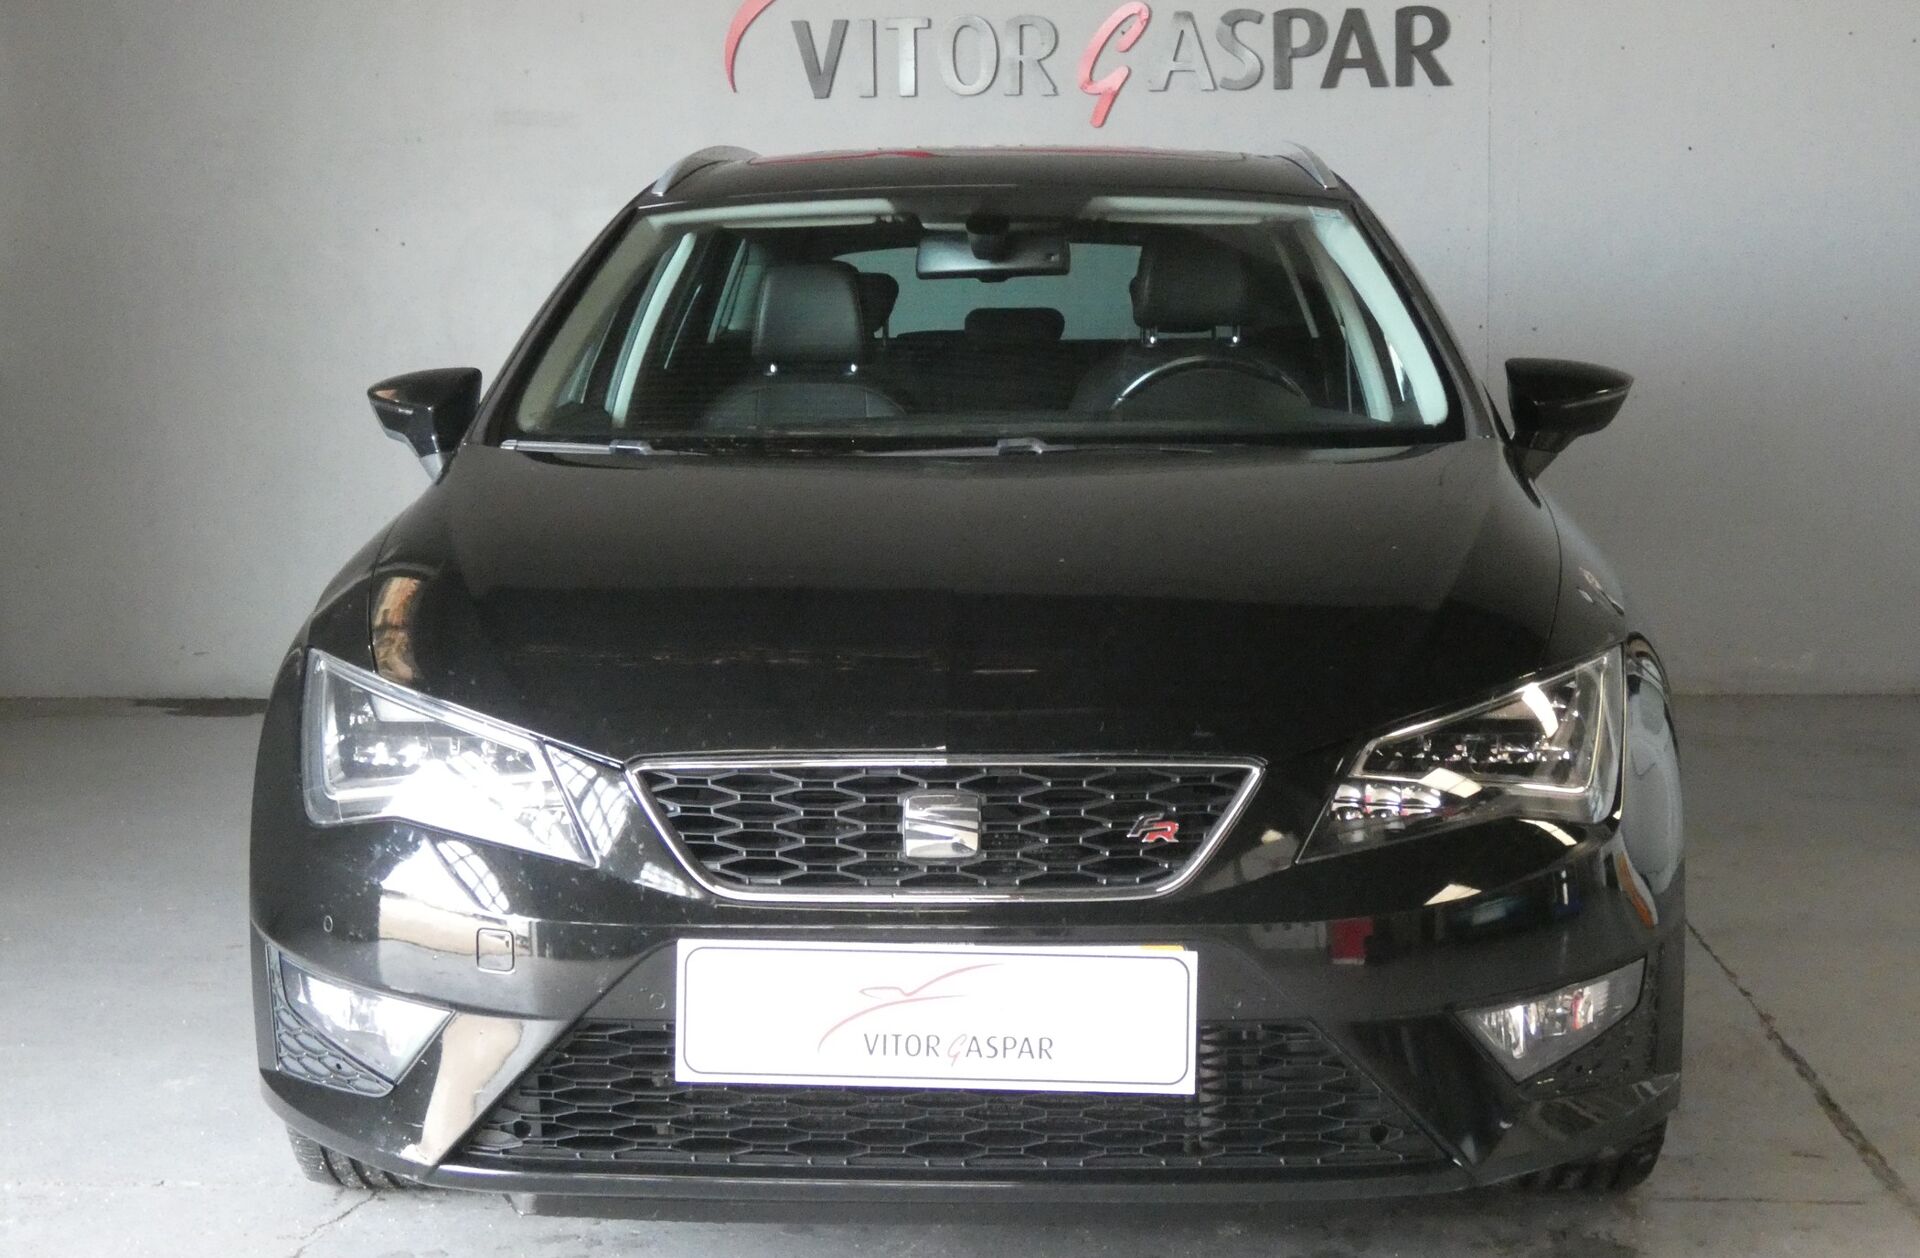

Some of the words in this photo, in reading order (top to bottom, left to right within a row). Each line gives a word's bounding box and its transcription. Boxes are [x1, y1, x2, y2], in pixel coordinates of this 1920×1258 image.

[791, 15, 1060, 100] VITOR
[1078, 1, 1452, 128] GASPAR
[863, 1032, 940, 1059] VITOR
[946, 1033, 1054, 1067] GASPAR
